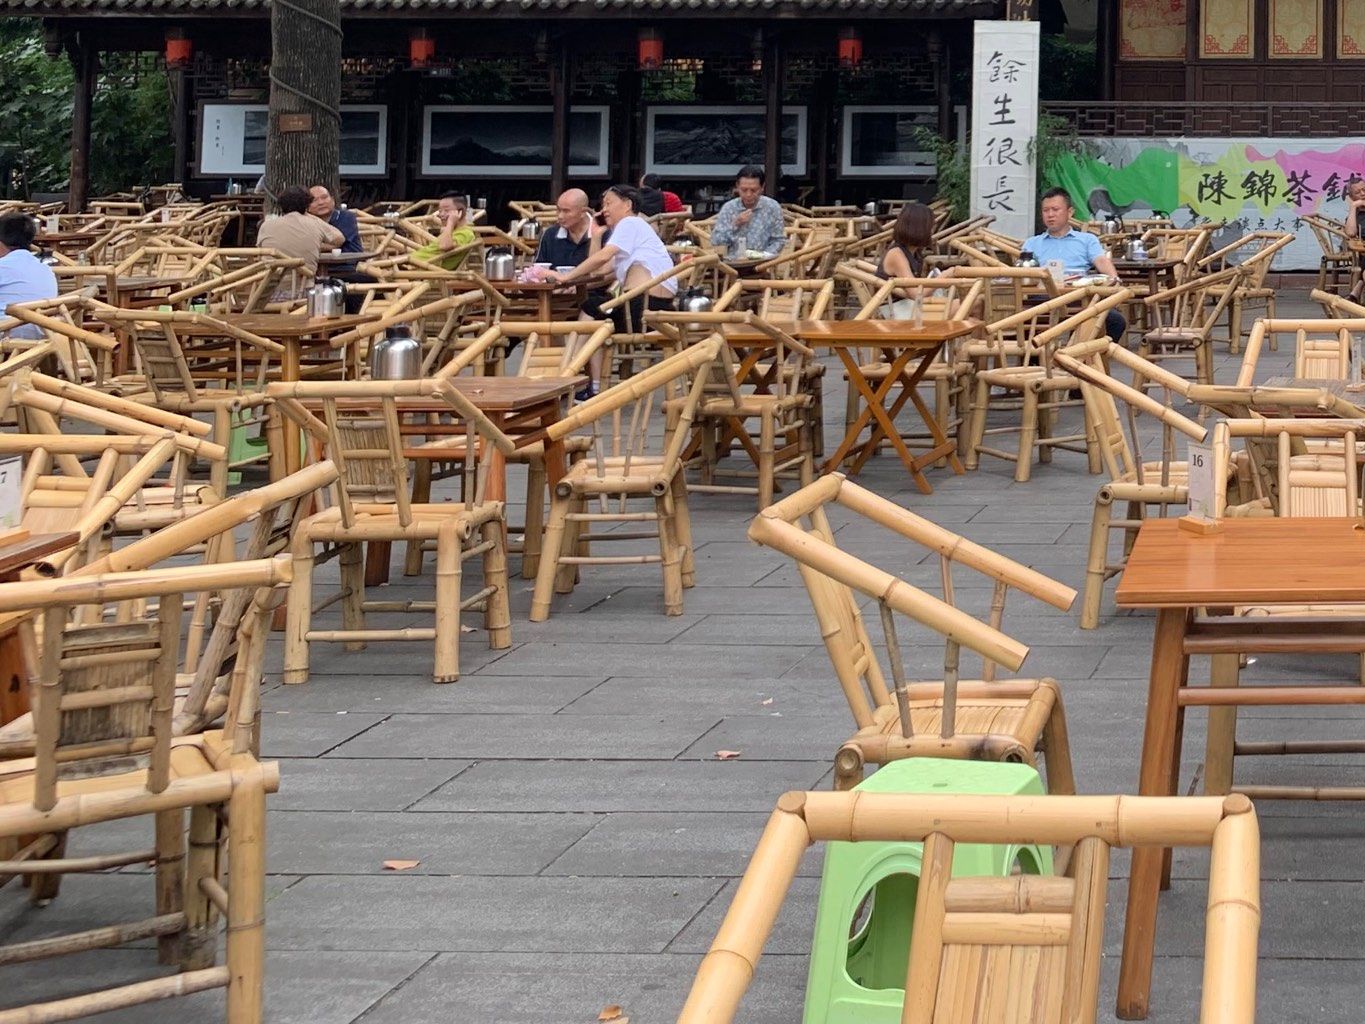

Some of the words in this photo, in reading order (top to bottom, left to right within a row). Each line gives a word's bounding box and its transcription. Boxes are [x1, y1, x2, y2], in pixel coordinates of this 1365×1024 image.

[982, 51, 1026, 212] 餘生很長
[1193, 454, 1203, 467] 16
